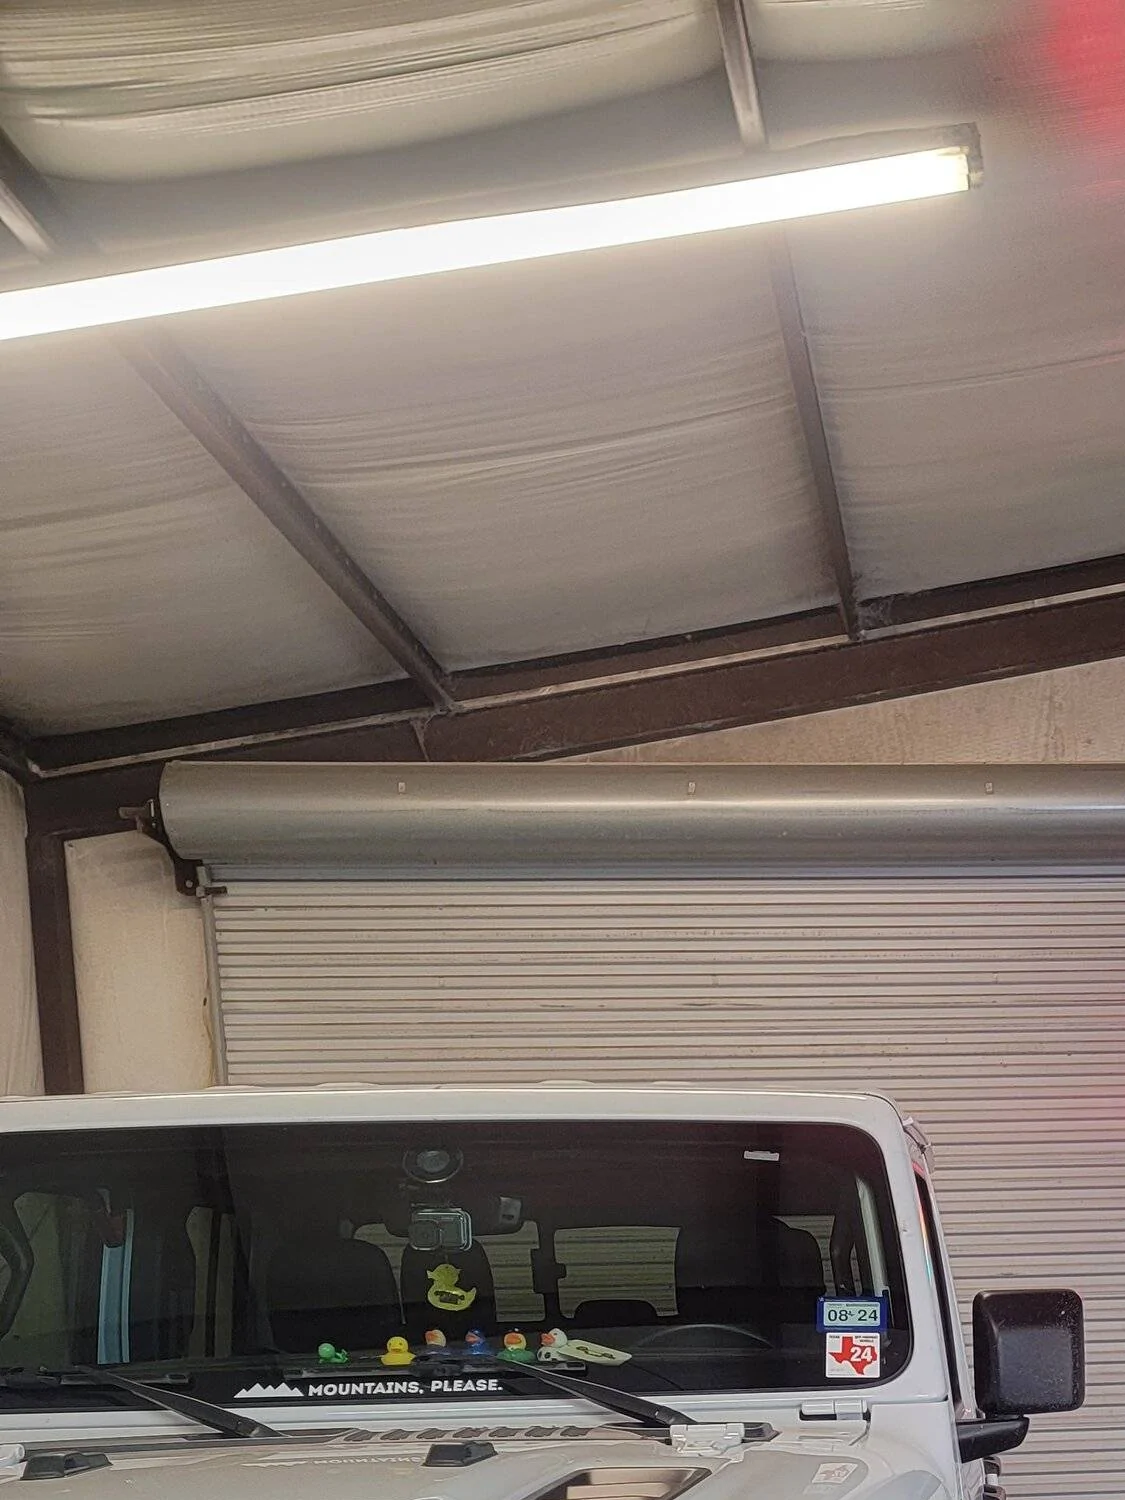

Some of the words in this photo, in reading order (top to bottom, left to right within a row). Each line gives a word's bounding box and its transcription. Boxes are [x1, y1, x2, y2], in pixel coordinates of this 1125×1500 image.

[827, 1309, 848, 1322] 08
[857, 1309, 878, 1322] 24
[850, 1346, 873, 1363] 24
